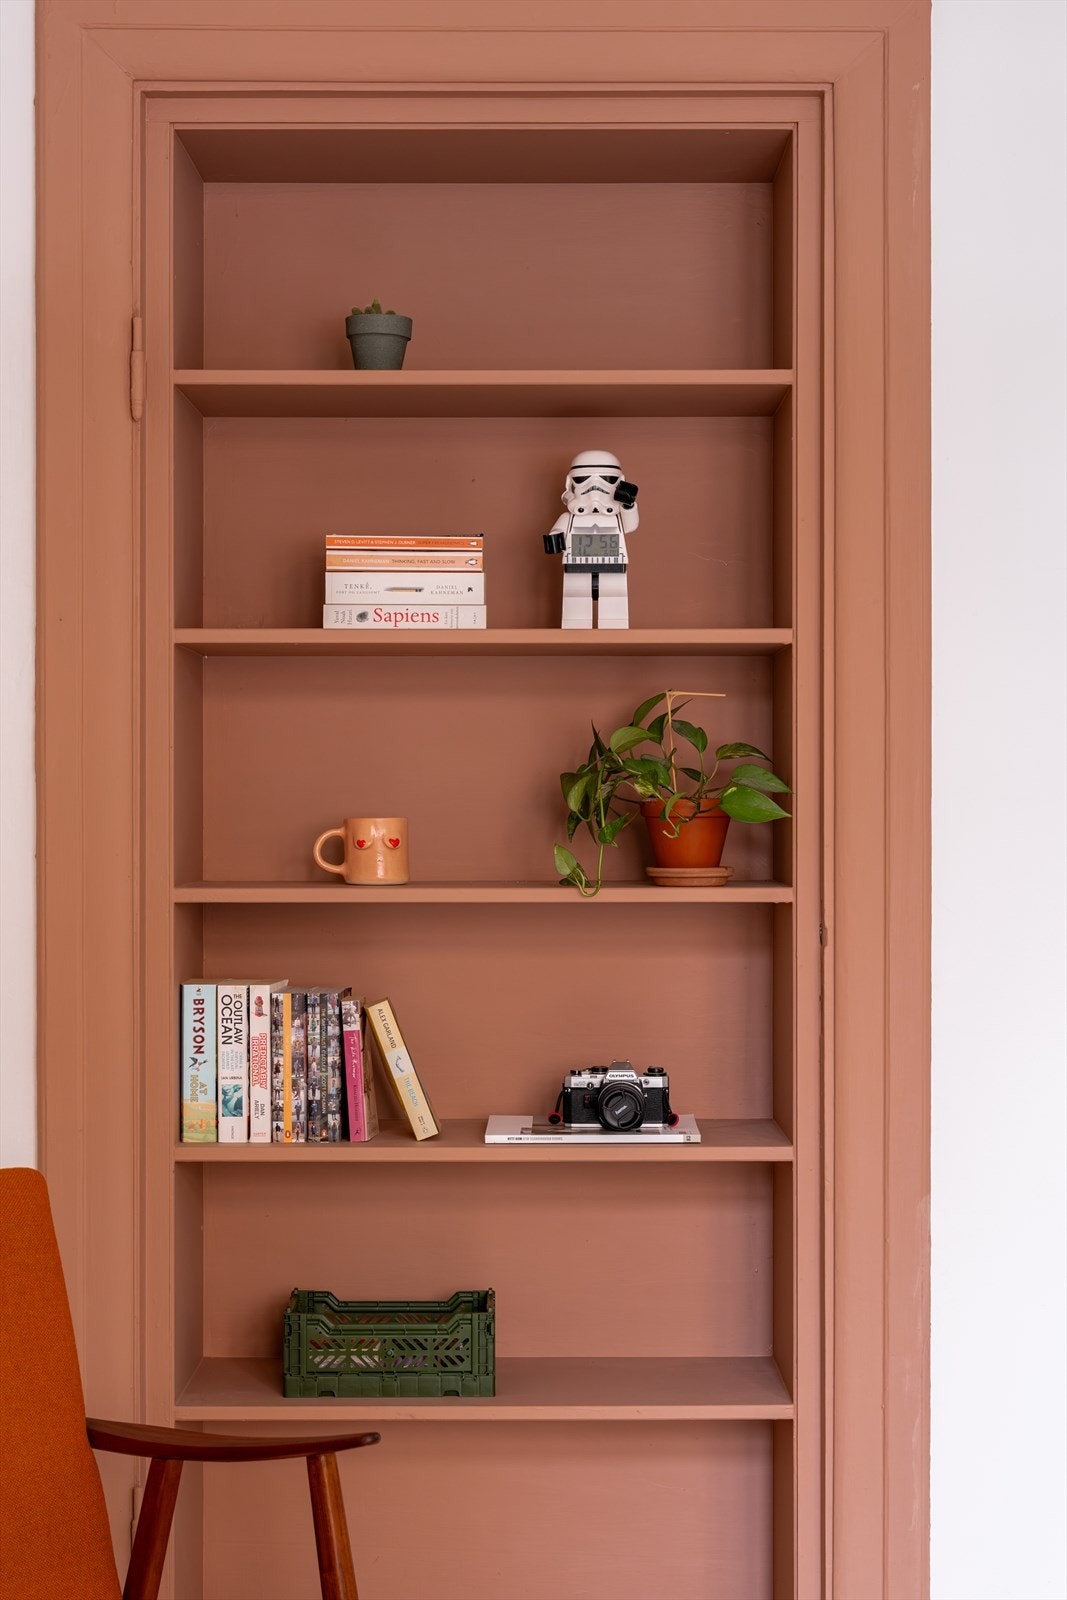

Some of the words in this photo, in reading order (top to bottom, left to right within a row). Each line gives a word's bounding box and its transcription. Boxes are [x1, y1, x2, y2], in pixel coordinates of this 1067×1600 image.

[373, 607, 440, 628] Sapiens
[192, 998, 205, 1055] BRYSON
[221, 994, 233, 1045] OCEAN
[233, 1000, 243, 1045] OUTLAW
[377, 1008, 388, 1024] ALEX
[382, 1022, 397, 1049] GARLAND
[251, 1036, 260, 1087] IRRATIONAL
[259, 1032, 268, 1090] PREDICTABLY
[190, 1074, 199, 1103] HOME
[199, 1081, 208, 1095] AT
